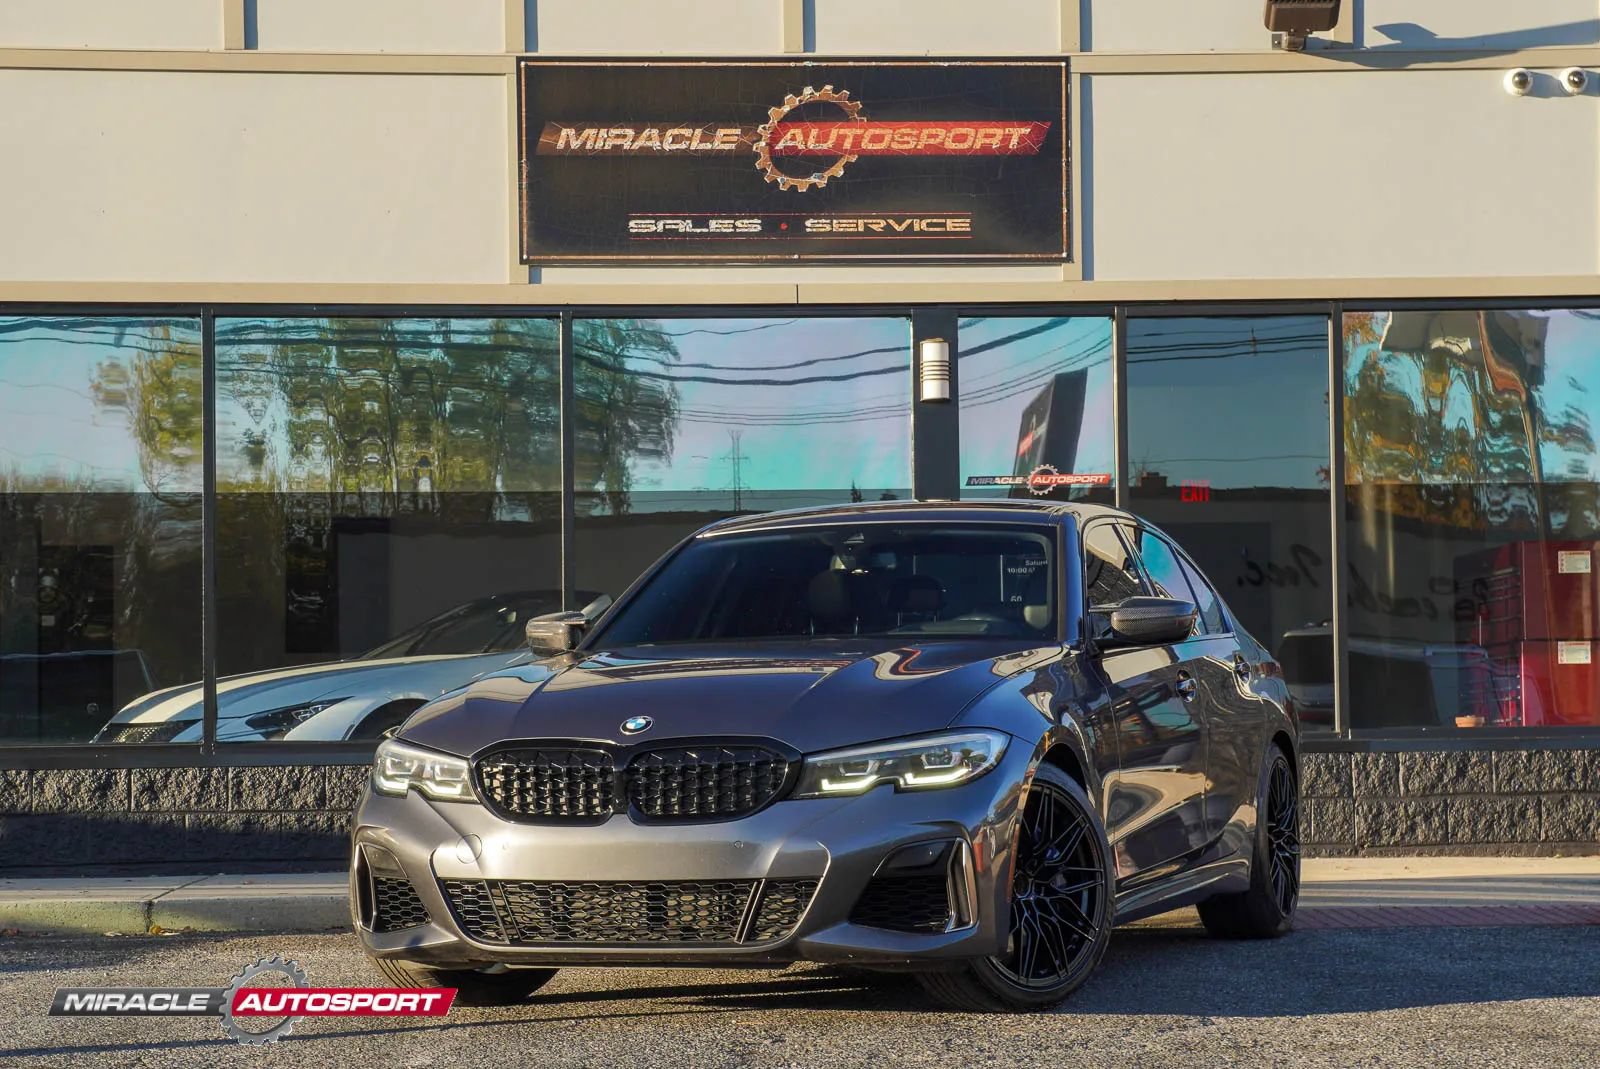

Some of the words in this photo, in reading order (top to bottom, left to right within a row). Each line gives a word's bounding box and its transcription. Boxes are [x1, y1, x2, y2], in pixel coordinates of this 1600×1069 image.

[555, 127, 742, 151] MIRACLE
[774, 126, 1032, 150] AUTOSPORT
[628, 218, 762, 233] SALES
[804, 218, 972, 233] SERVICE
[970, 476, 1024, 485] MIRACLE
[1033, 474, 1106, 484] AUTOSPORT
[1181, 480, 1209, 503] EXIT
